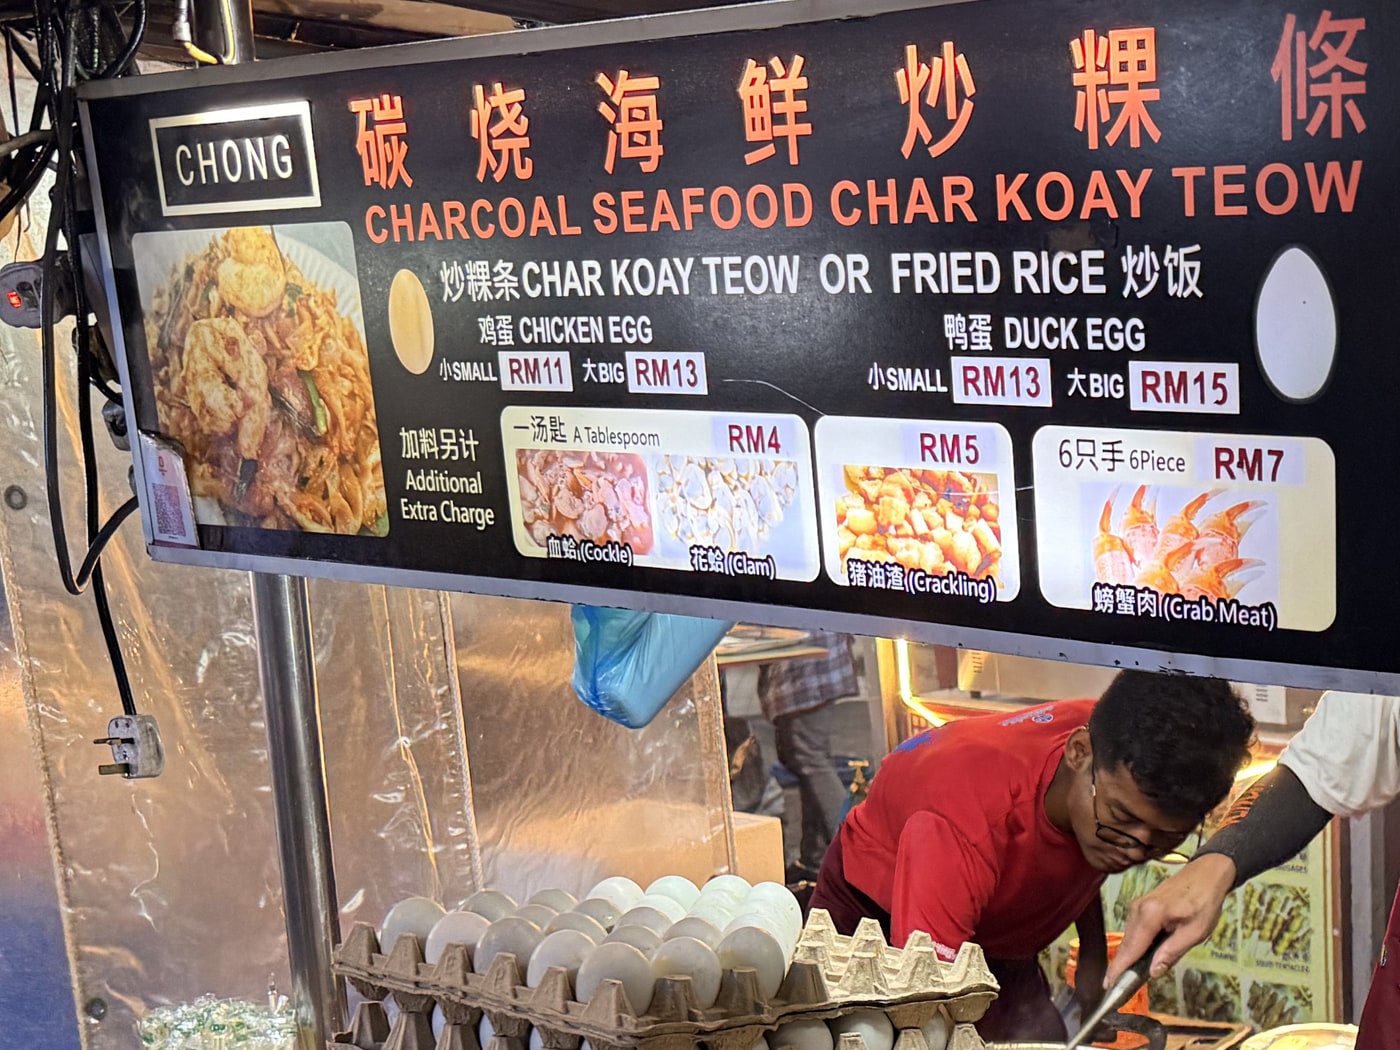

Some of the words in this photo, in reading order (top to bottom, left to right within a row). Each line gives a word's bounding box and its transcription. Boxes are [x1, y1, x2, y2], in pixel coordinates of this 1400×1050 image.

[175, 134, 294, 187] CHONG
[365, 197, 582, 245] CHARCOAL
[593, 183, 813, 234] SEAFOOD
[830, 176, 976, 226] CHAR
[996, 168, 1153, 221] KOAY
[1172, 160, 1363, 217] TEOW
[611, 257, 695, 296] KOAY
[702, 254, 801, 295] TEOW
[820, 252, 873, 295] OR
[891, 251, 1000, 295] FRIED
[1013, 249, 1107, 295] RICE
[1121, 243, 1205, 300] 炒饭
[478, 314, 515, 346] 鸡蛋
[519, 316, 603, 344] CHICKEN
[608, 315, 653, 344] EGG
[944, 313, 993, 351] 鸭蛋
[1004, 316, 1079, 350] DUCK
[1086, 317, 1146, 351] EGG
[508, 357, 564, 385] RM11
[635, 358, 699, 388] RM13
[962, 365, 1041, 399] RM13
[1140, 370, 1229, 406] RM15
[399, 426, 480, 462] 加料另计
[513, 415, 567, 444] 一汤匙
[573, 427, 582, 443] A
[728, 423, 782, 454] RM4
[919, 432, 979, 466] RM5
[1058, 435, 1125, 473] 6只手
[1128, 449, 1187, 474] 6Piece
[1213, 445, 1285, 484] RM7
[405, 469, 483, 495] Additional
[400, 498, 438, 522] Extra
[440, 500, 495, 532] Charge
